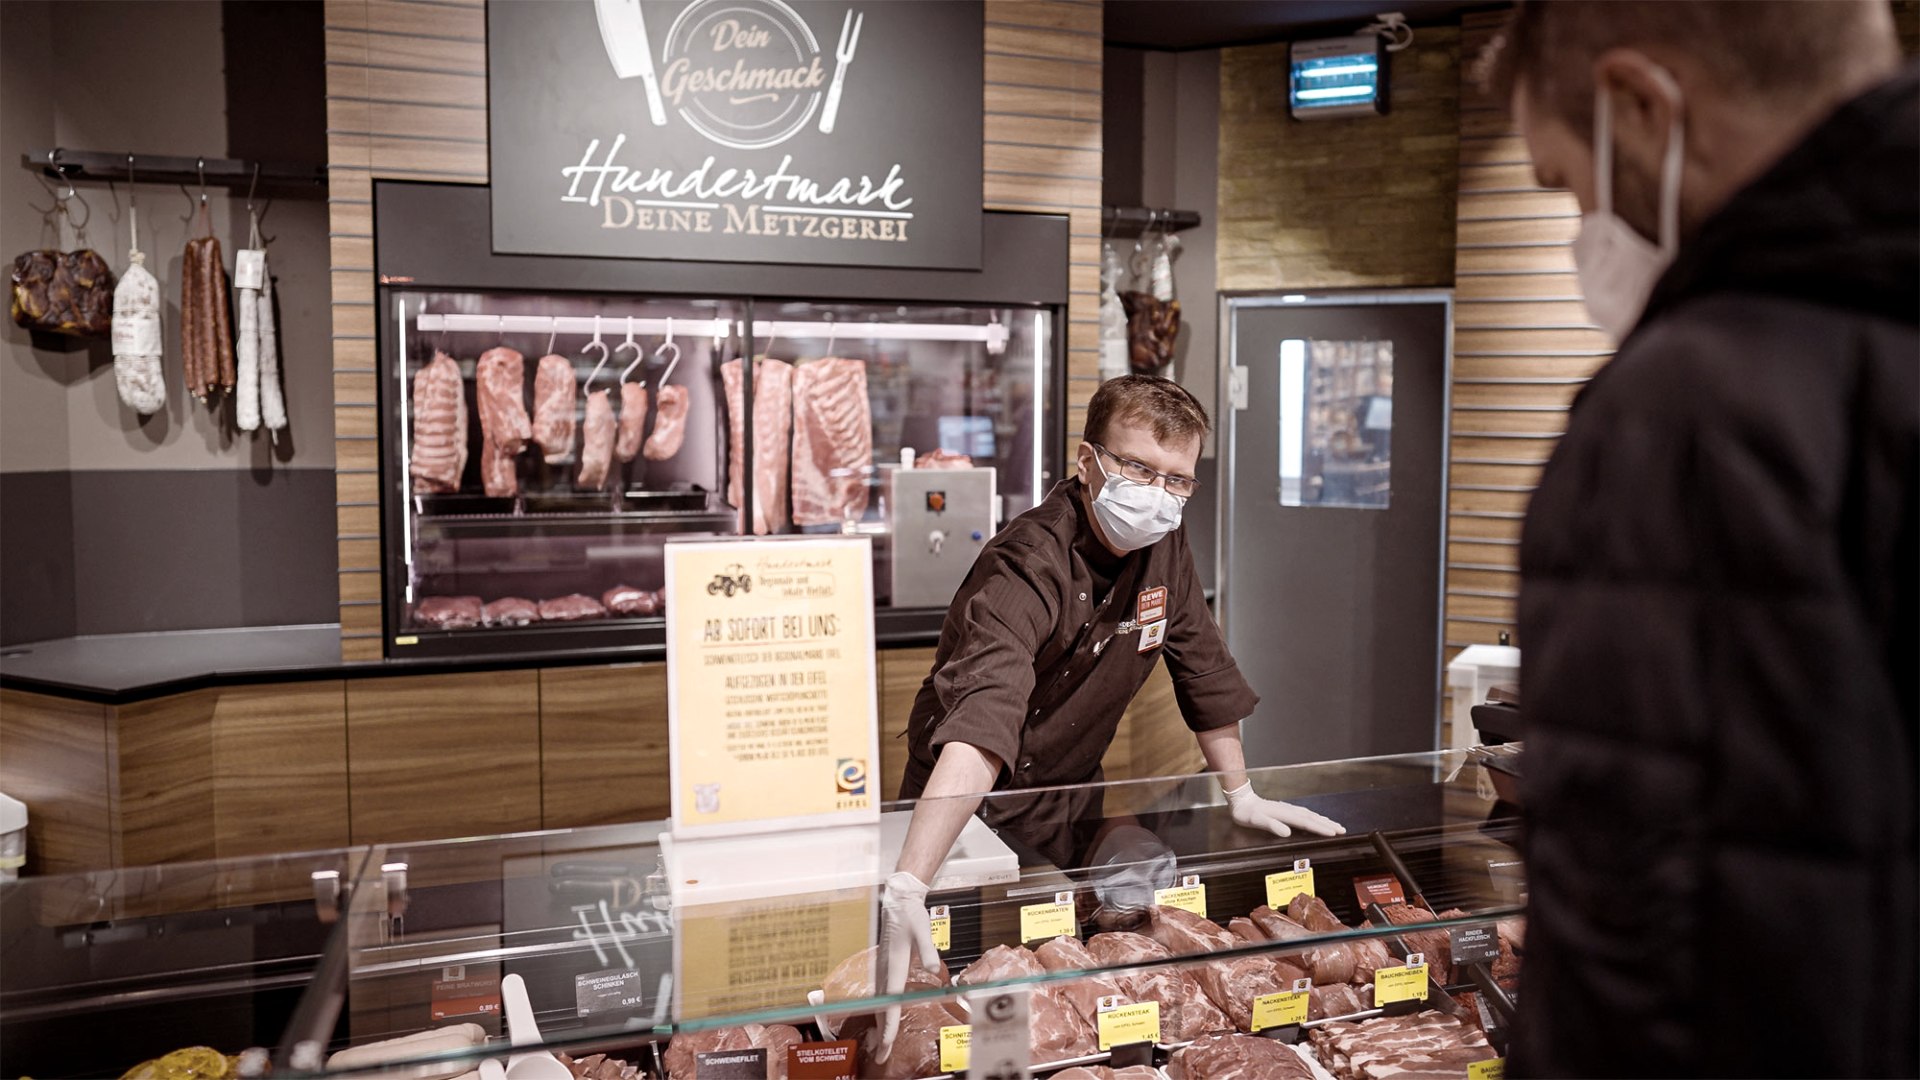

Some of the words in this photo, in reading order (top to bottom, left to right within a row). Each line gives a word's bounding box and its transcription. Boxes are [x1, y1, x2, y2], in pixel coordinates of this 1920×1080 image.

[711, 19, 772, 52] Dein
[661, 56, 827, 102] Geschmack
[561, 134, 914, 211] Hundertmark
[601, 195, 713, 233] DEINE
[723, 203, 909, 243] METZGEREI
[1141, 590, 1164, 602] REWE
[704, 618, 723, 642] AB
[727, 616, 776, 641] SOFORT
[783, 615, 803, 639] BEI
[578, 971, 639, 987] SCHWEINEGULASCH
[593, 980, 625, 991] SCHINKEN
[1262, 994, 1301, 1005] NACKENSTEAK
[1107, 1009, 1150, 1020] RÜCKENSTEAK
[796, 1046, 849, 1058] STIELKOTELETT
[705, 1054, 760, 1066] SCHWEINEFILET
[799, 1055, 815, 1064] VOM
[815, 1054, 846, 1063] SCHWEIN
